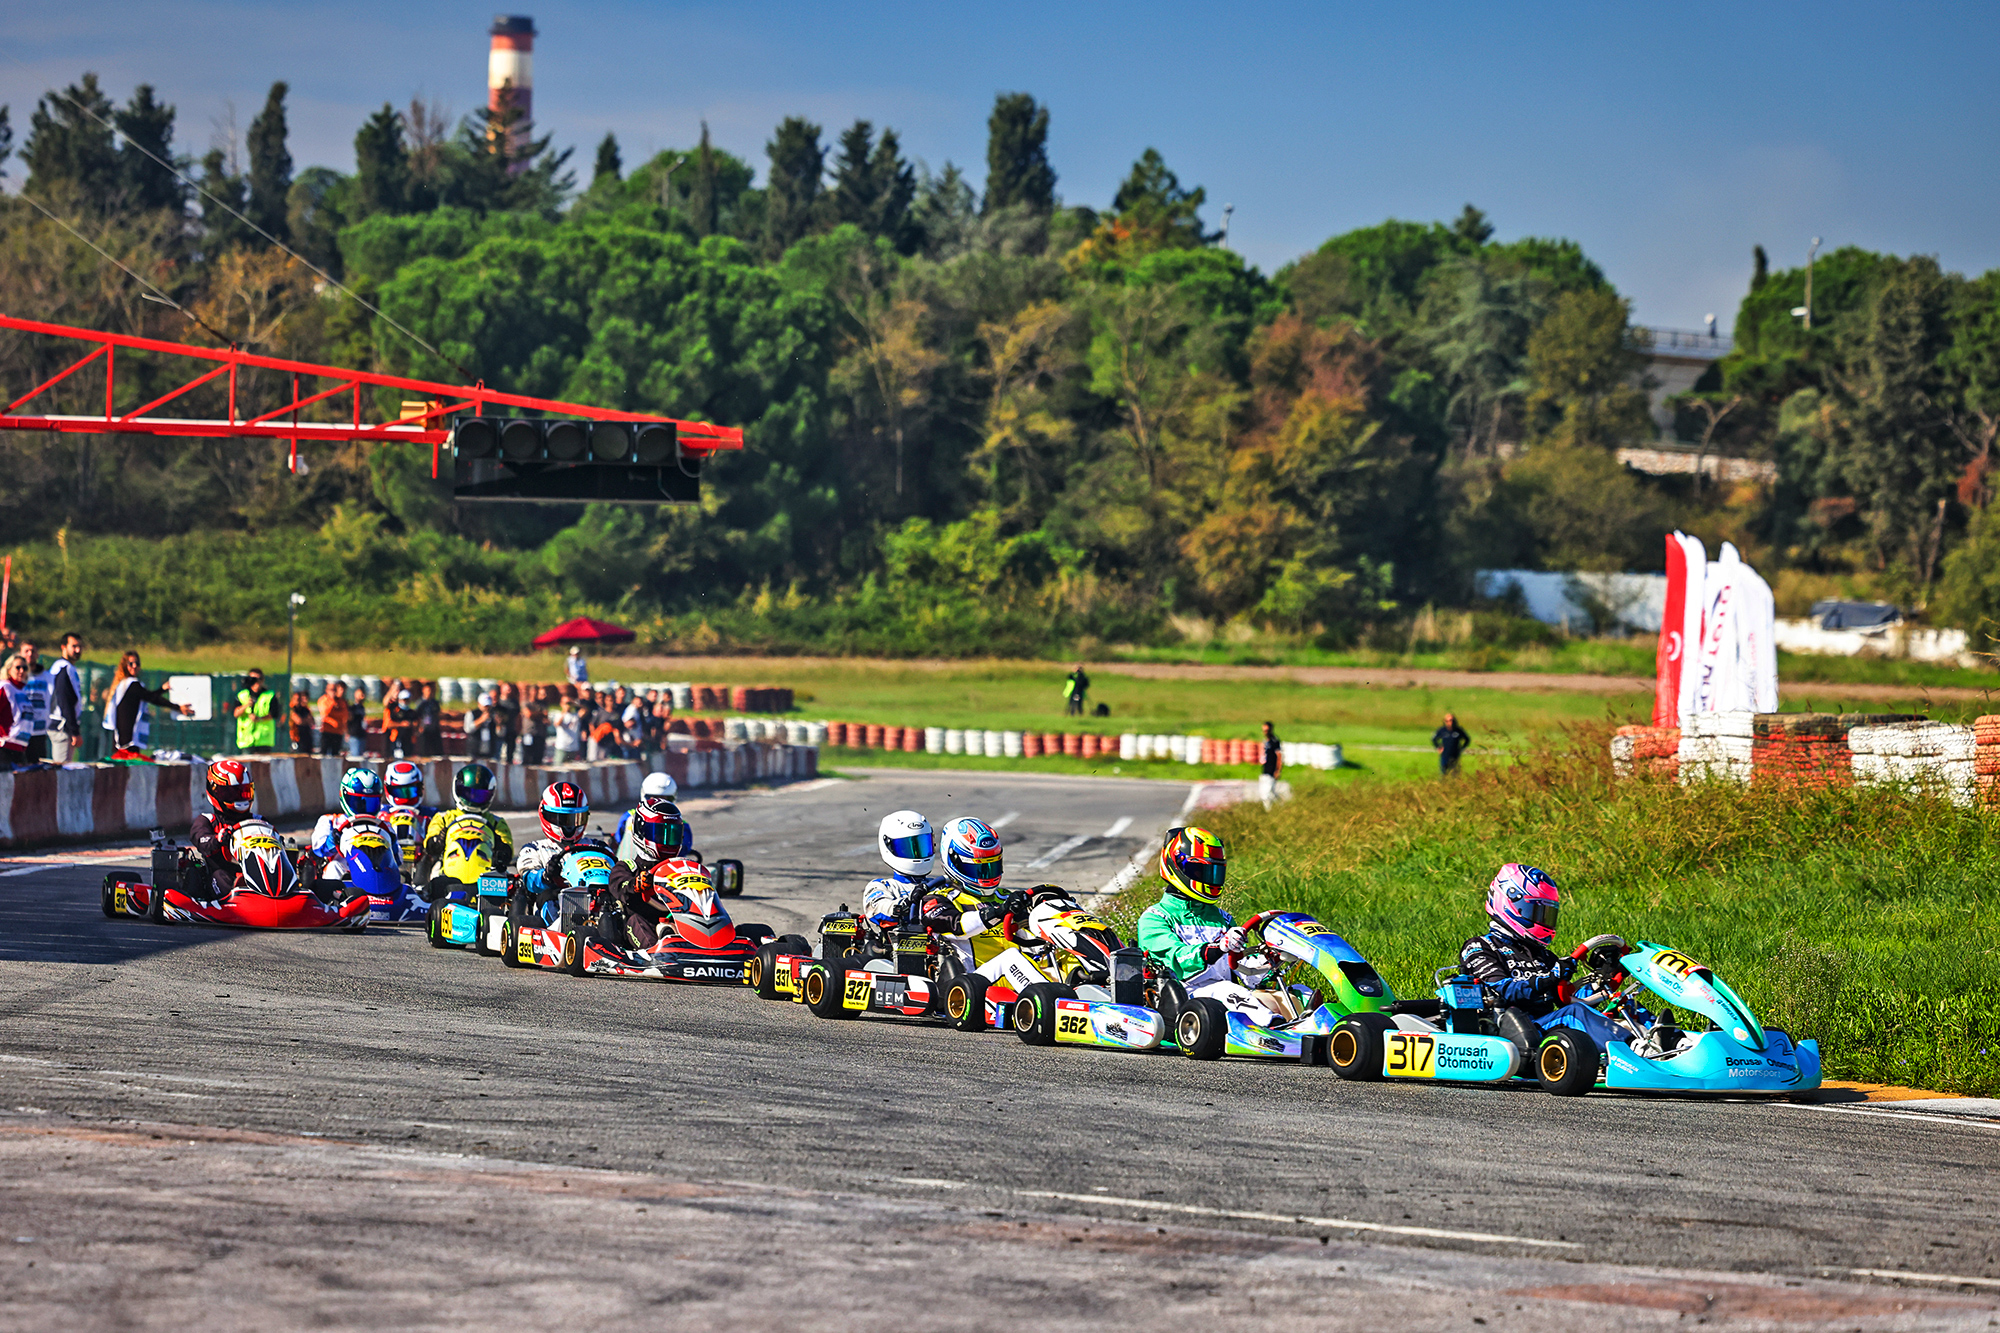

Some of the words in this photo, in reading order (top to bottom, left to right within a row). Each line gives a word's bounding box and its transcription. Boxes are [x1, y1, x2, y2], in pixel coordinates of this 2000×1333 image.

[481, 879, 507, 889] BOM
[1073, 914, 1099, 925] 32
[1303, 925, 1334, 935] 36
[683, 967, 744, 979] SANICA
[845, 980, 871, 1000] 327
[1454, 986, 1481, 998] BOM
[1058, 1015, 1088, 1034] 362
[1389, 1035, 1434, 1071] 317
[1438, 1043, 1488, 1057] Borusan
[1438, 1056, 1494, 1070] Otomotiv
[1728, 1067, 1781, 1078] Motorsport
